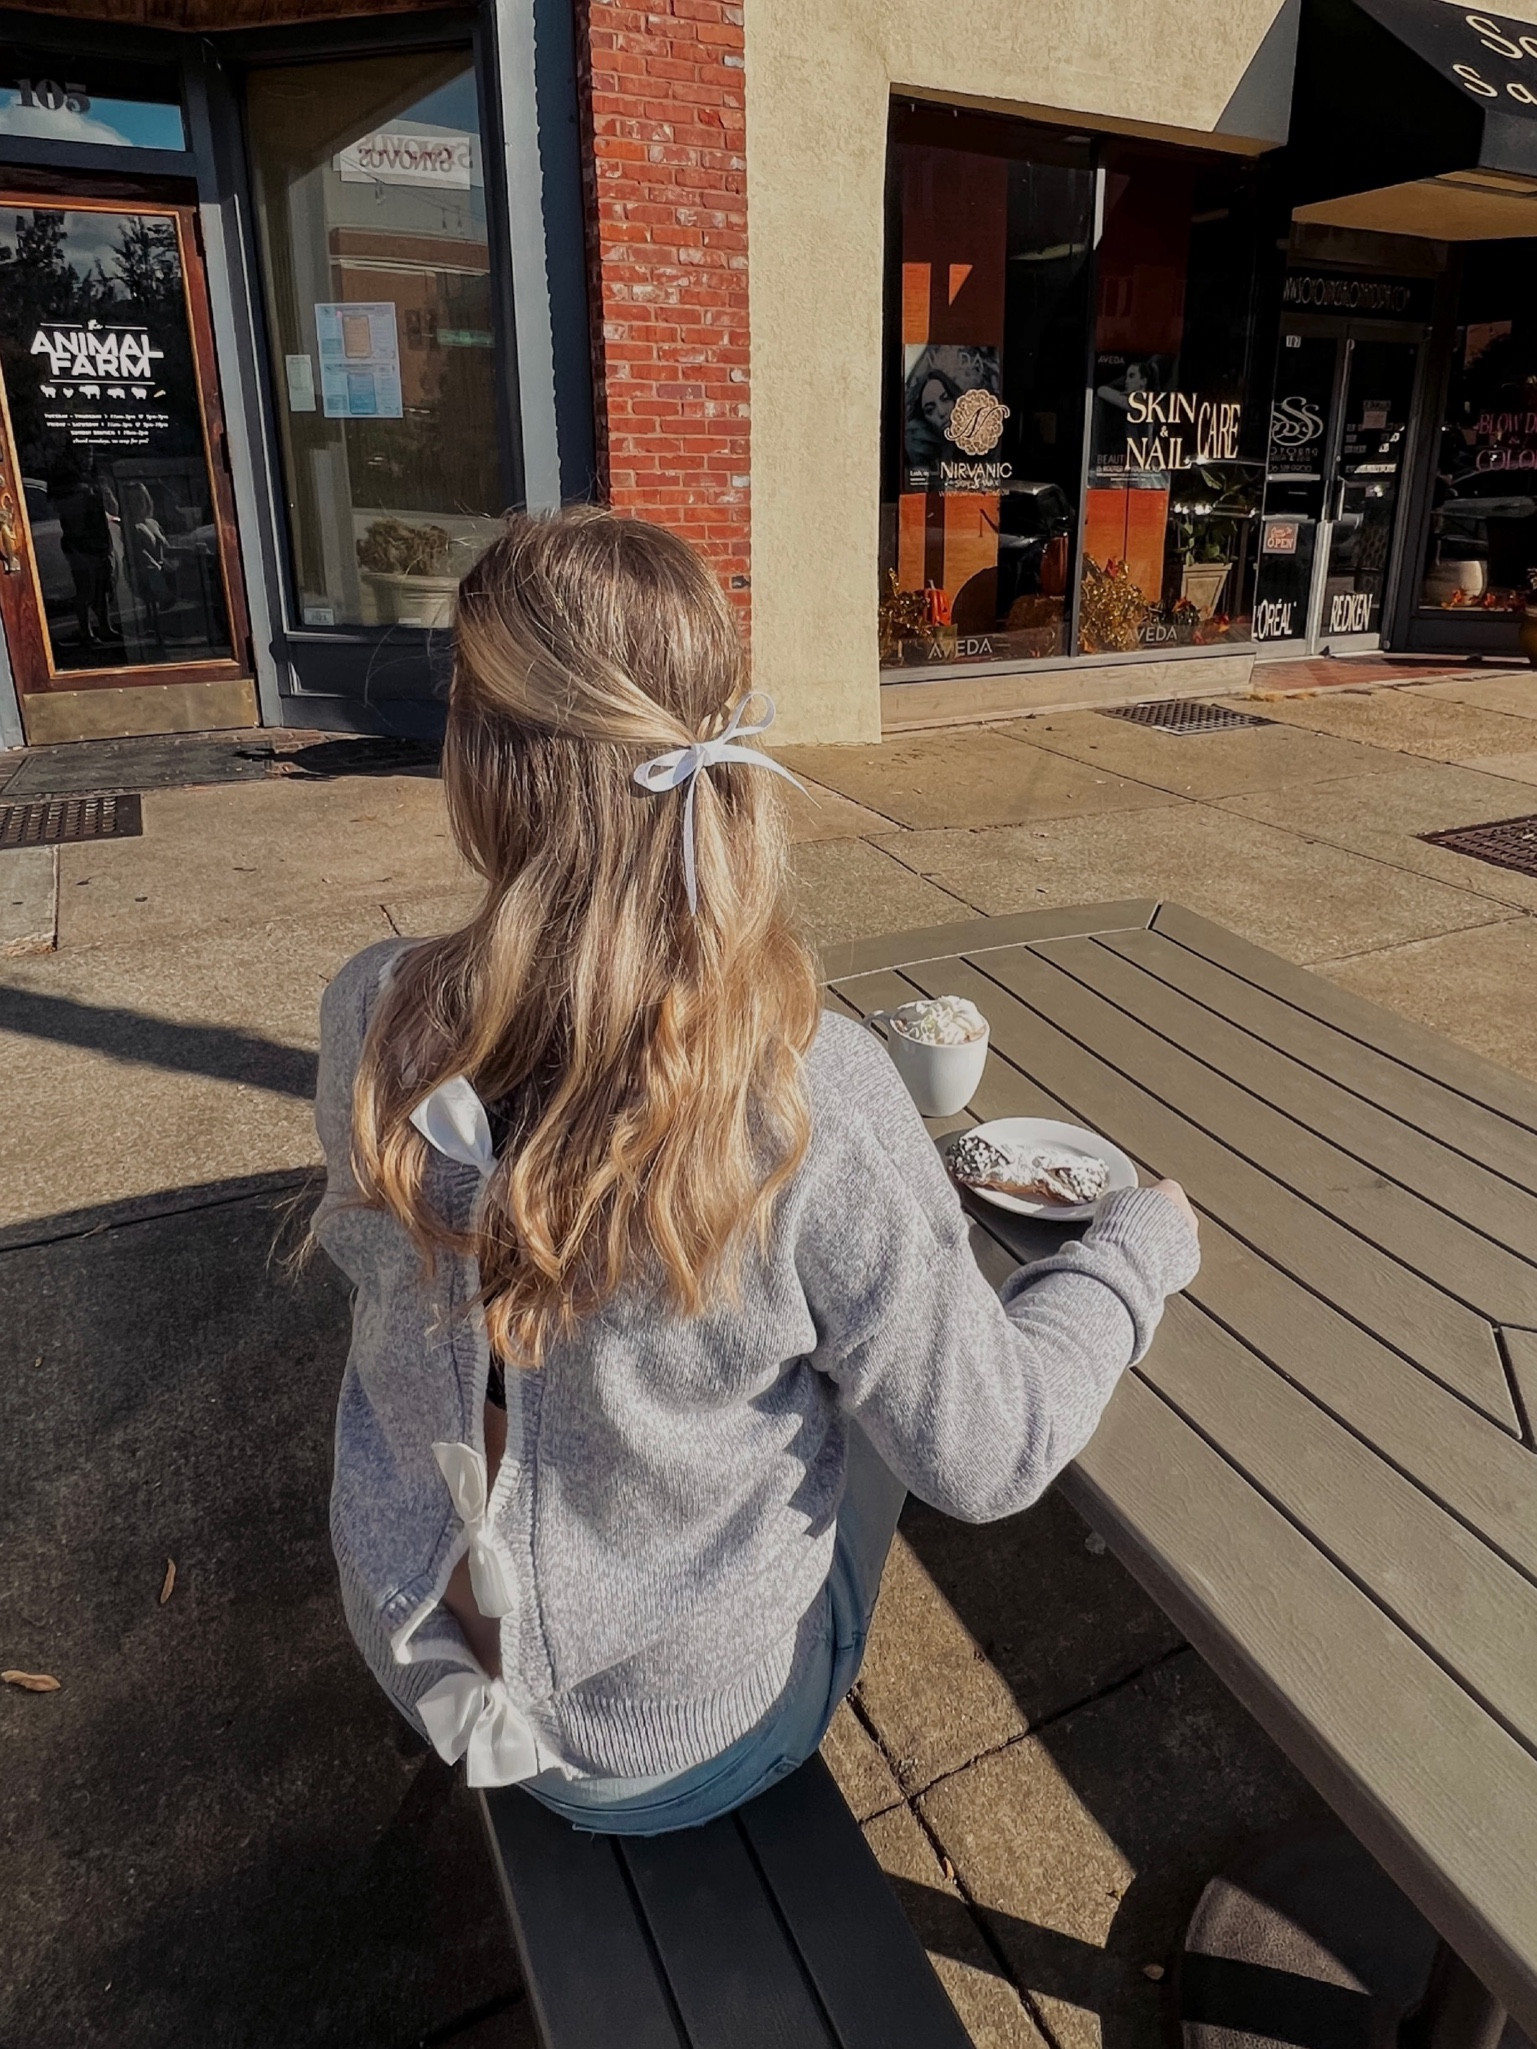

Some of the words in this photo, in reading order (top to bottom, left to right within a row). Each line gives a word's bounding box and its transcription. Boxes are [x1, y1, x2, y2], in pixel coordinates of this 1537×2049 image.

[13, 78, 91, 114] 105
[30, 330, 164, 358] ANIMAL
[50, 351, 151, 378] FARM
[1097, 355, 1125, 364] AVEDA
[1126, 391, 1198, 424] SKIN
[1159, 425, 1169, 437] &
[1479, 413, 1522, 434] BLOW
[1525, 412, 1537, 432] D
[1124, 437, 1192, 471] NAIL
[1197, 401, 1241, 459] CARE
[940, 461, 1012, 479] NIRVANIC
[1476, 449, 1537, 473] COLO
[1267, 538, 1294, 548] OPEN
[1251, 599, 1293, 640] L'ORÉAL
[1329, 593, 1373, 633] REDKEN
[1126, 625, 1178, 644] AVEDA
[927, 637, 992, 660] AVEDA
